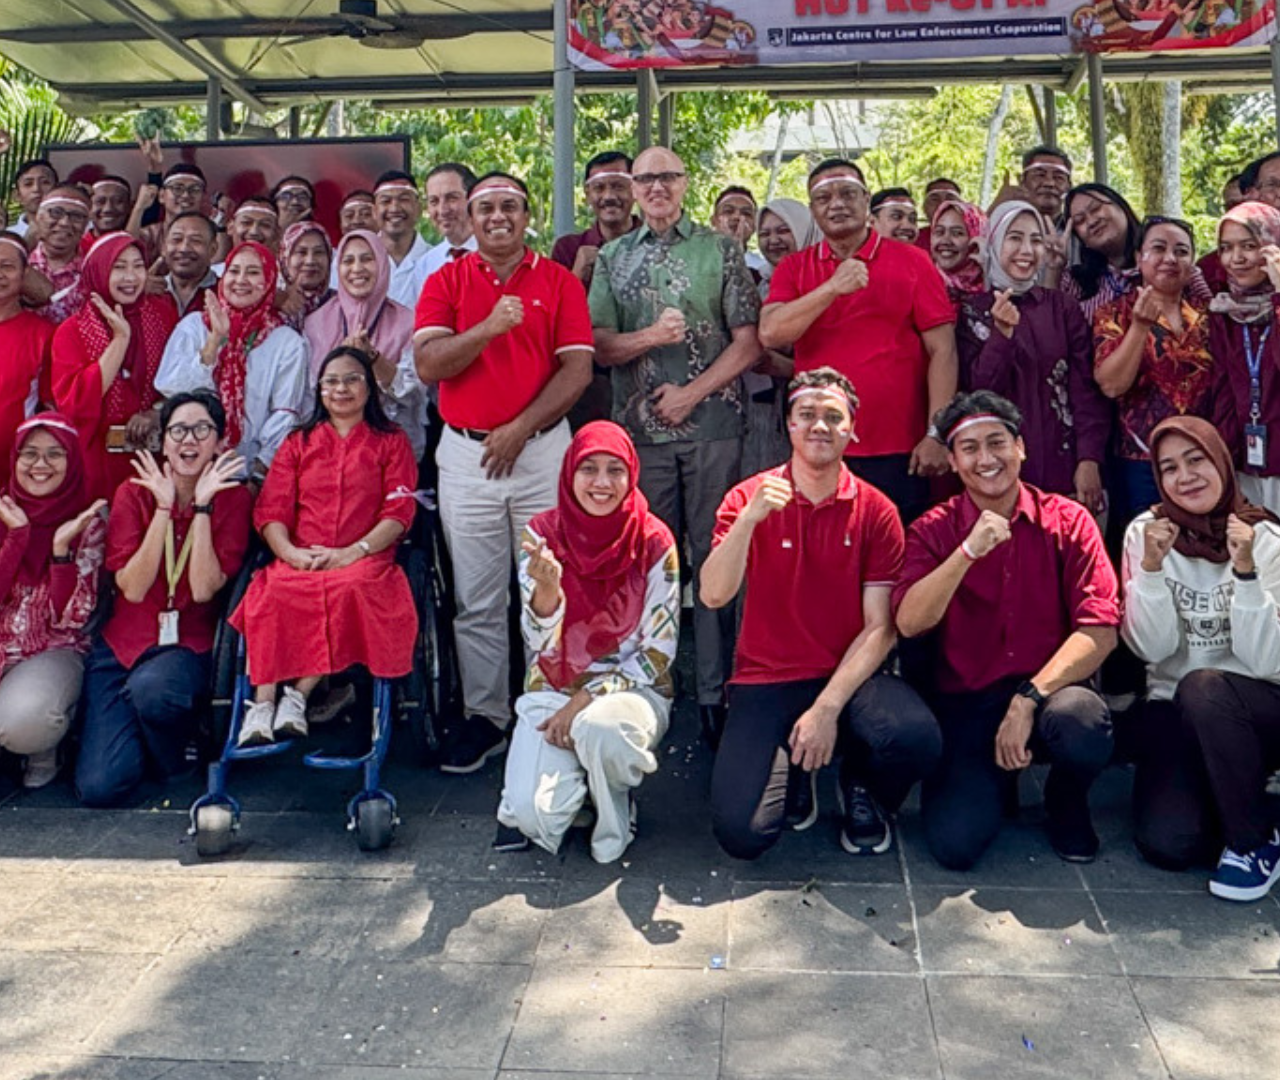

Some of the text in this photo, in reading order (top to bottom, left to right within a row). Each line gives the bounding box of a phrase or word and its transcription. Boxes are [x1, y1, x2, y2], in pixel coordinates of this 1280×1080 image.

[791, 21, 1061, 42] Jakarta Centre for Law Enforcement Cooperation
